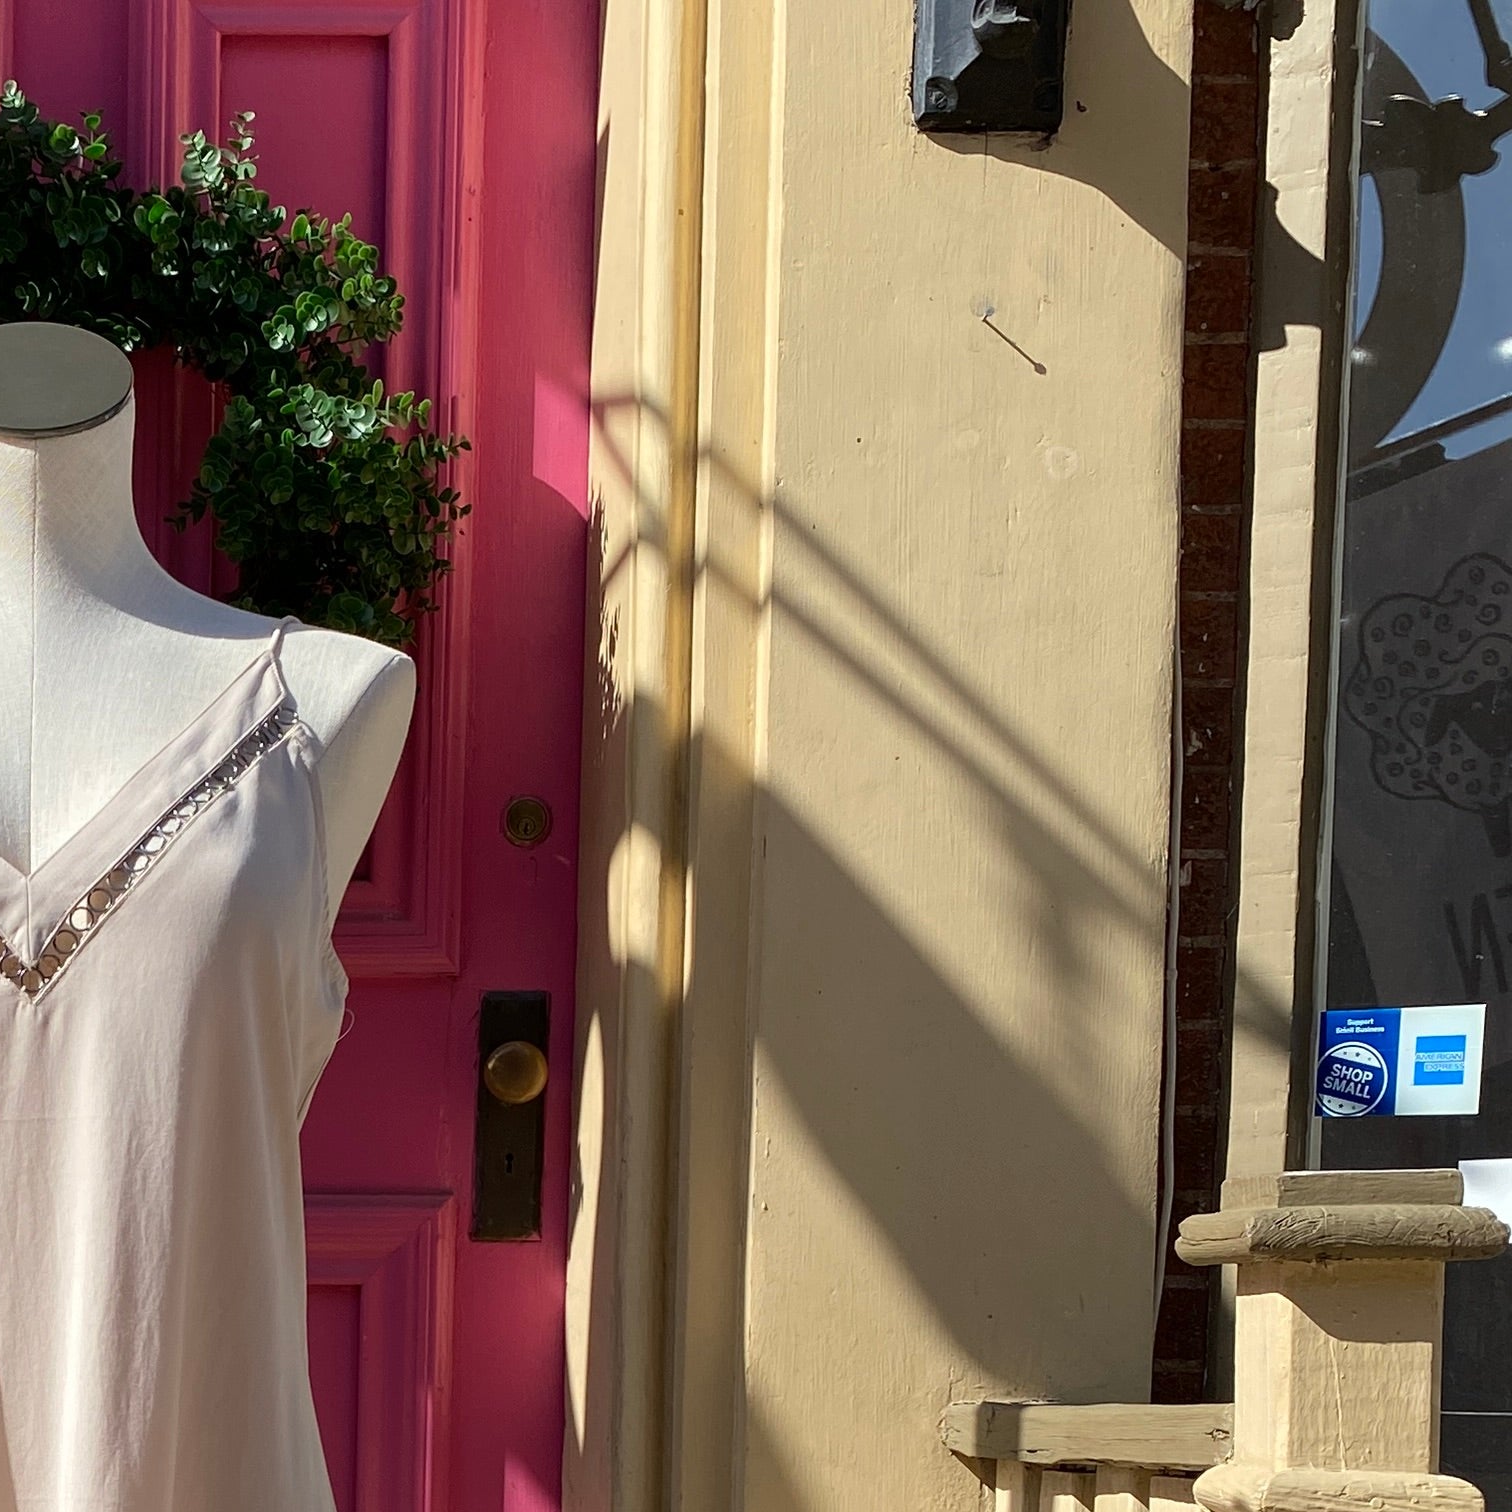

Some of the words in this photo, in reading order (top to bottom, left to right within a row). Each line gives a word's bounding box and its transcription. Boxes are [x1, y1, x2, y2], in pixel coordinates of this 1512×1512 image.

[1347, 1018, 1374, 1026] Support
[1415, 1053, 1462, 1061] AMERICAN
[1331, 1063, 1373, 1083] SHOP
[1323, 1076, 1371, 1099] SMALL
